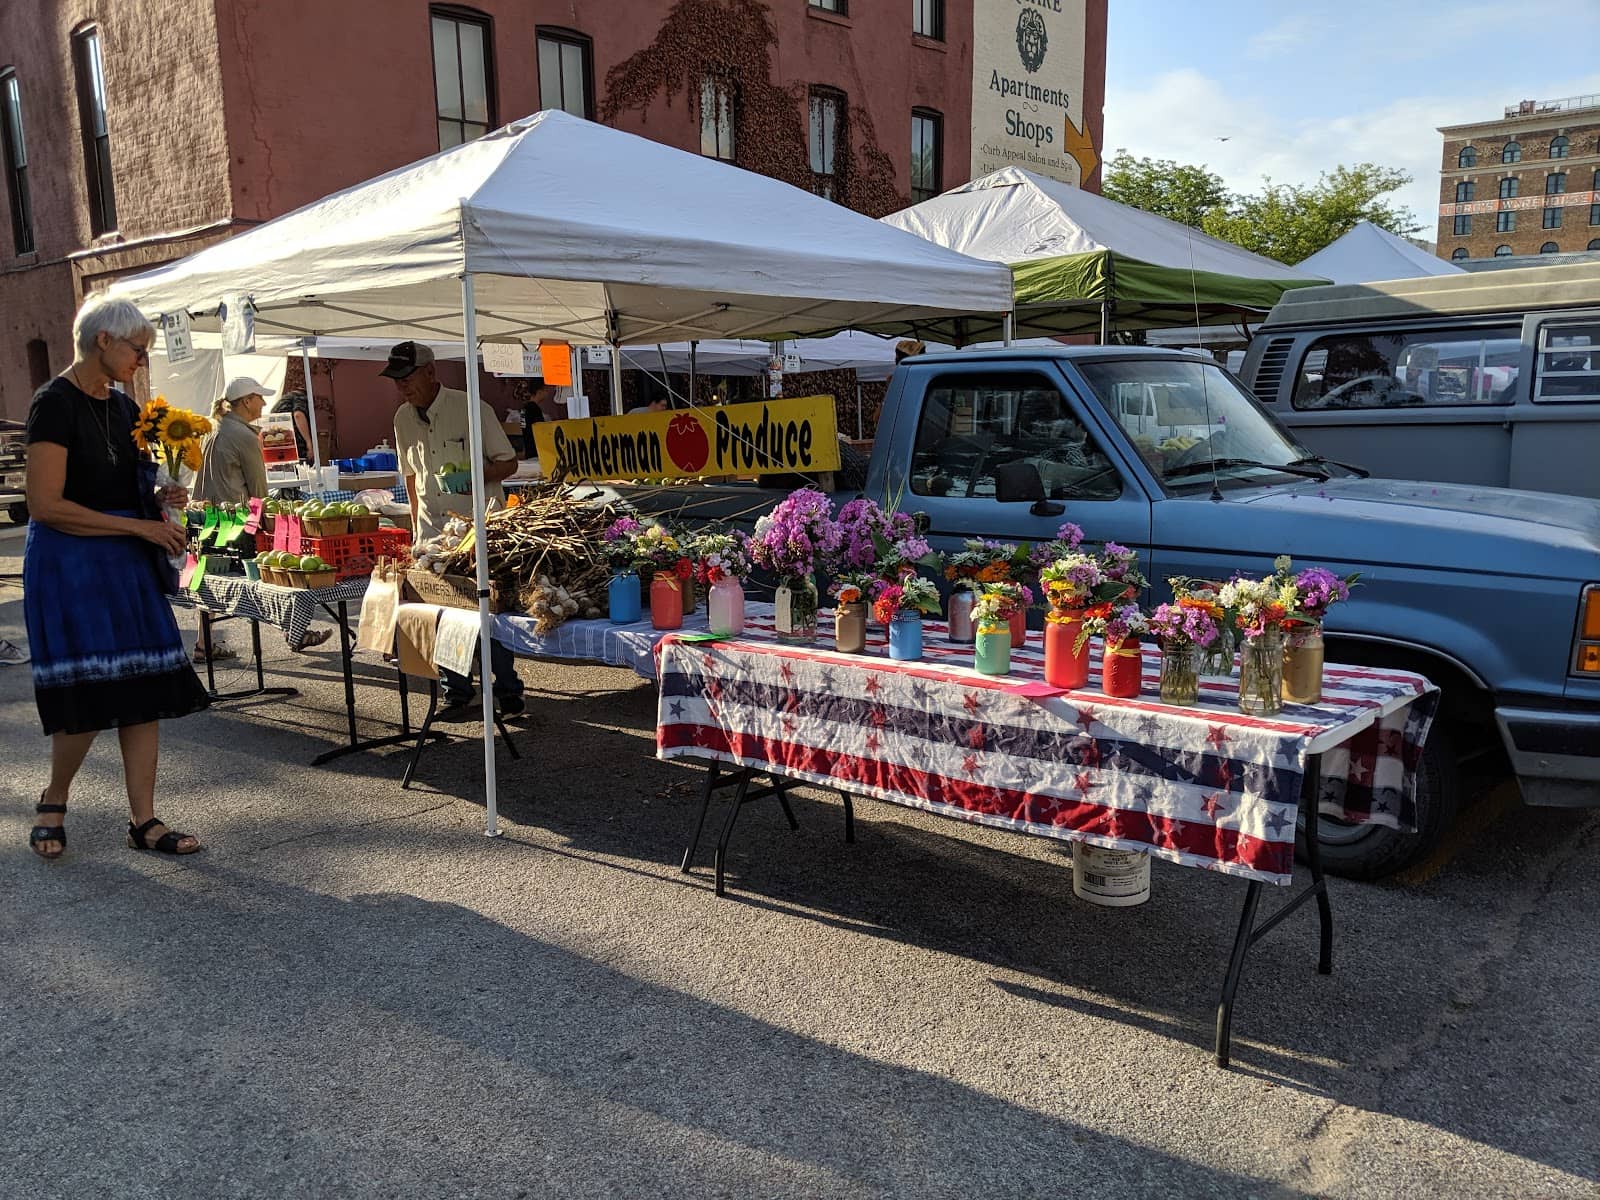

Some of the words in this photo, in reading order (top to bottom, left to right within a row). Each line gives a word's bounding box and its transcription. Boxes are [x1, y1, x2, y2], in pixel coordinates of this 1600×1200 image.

[989, 69, 1070, 109] Apartments
[1005, 109, 1054, 148] Shops
[982, 143, 1000, 156] Curb
[1002, 149, 1026, 161] Appeal
[1027, 152, 1046, 165] Salon
[553, 418, 663, 478] Sunderman
[715, 403, 812, 470] Produce
[415, 581, 450, 597] FARMERS
